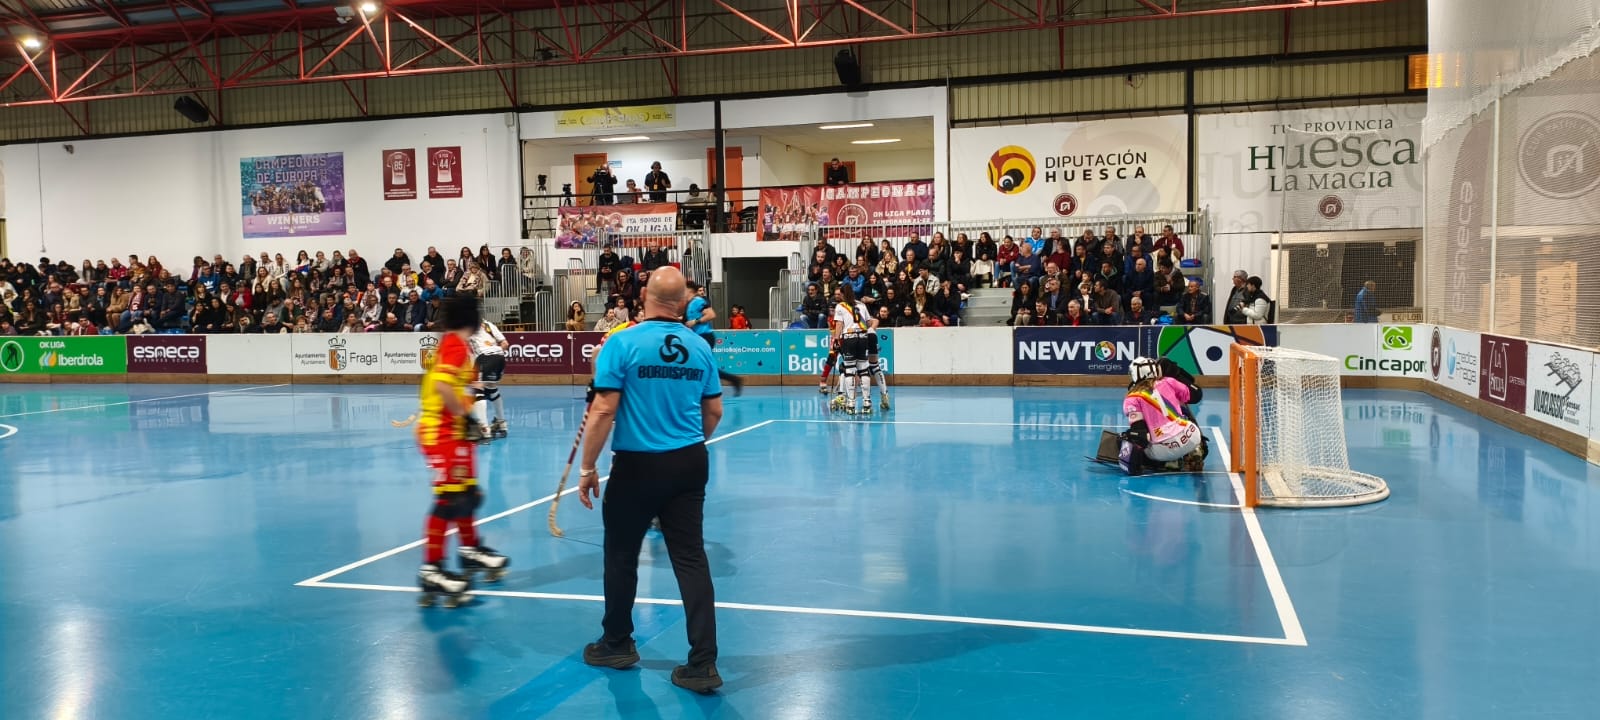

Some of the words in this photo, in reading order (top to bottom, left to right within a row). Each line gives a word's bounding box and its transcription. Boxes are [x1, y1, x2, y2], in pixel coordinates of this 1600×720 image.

[255, 156, 328, 170] CAMPEONAS
[394, 160, 403, 170] 85
[440, 158, 448, 168] 44
[1045, 149, 1147, 168] DIPUTACIÓN
[256, 172, 271, 184] DE
[275, 170, 318, 183] EUROPA
[1045, 166, 1146, 183] HUESCA
[266, 214, 320, 225] WINNERS
[134, 346, 200, 358] esneca
[350, 352, 378, 366] Fraga
[58, 353, 103, 367] Iberdrola
[638, 365, 705, 382] BORDISPORT
[1088, 363, 1122, 372] energies
